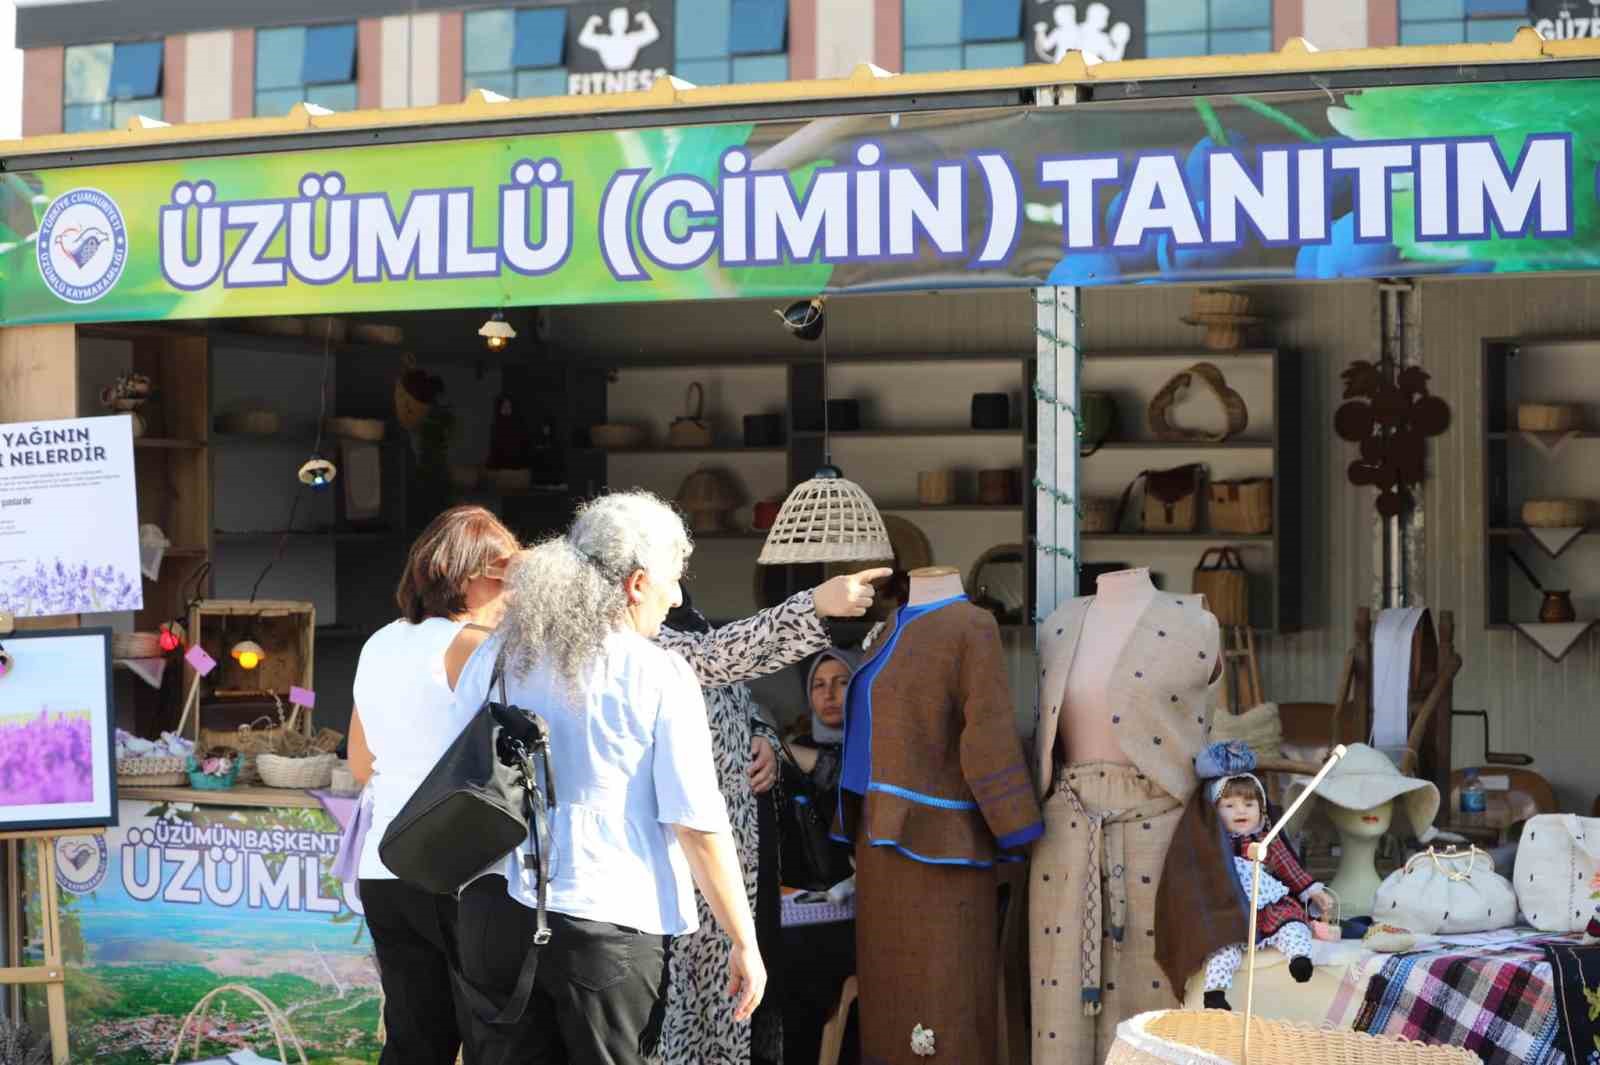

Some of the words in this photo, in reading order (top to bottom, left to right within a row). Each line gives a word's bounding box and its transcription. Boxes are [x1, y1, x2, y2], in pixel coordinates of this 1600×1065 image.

[568, 67, 667, 95] FITNES
[161, 159, 573, 290] ÜZÜMLÜ
[601, 141, 1020, 279] (CİMİN)
[1039, 134, 1570, 249] TANITIM
[2, 426, 90, 447] YAĞININ
[10, 442, 106, 466] NELERDİR
[156, 820, 240, 847] ÜZÜMÜN
[245, 826, 343, 855] BAŞKENT
